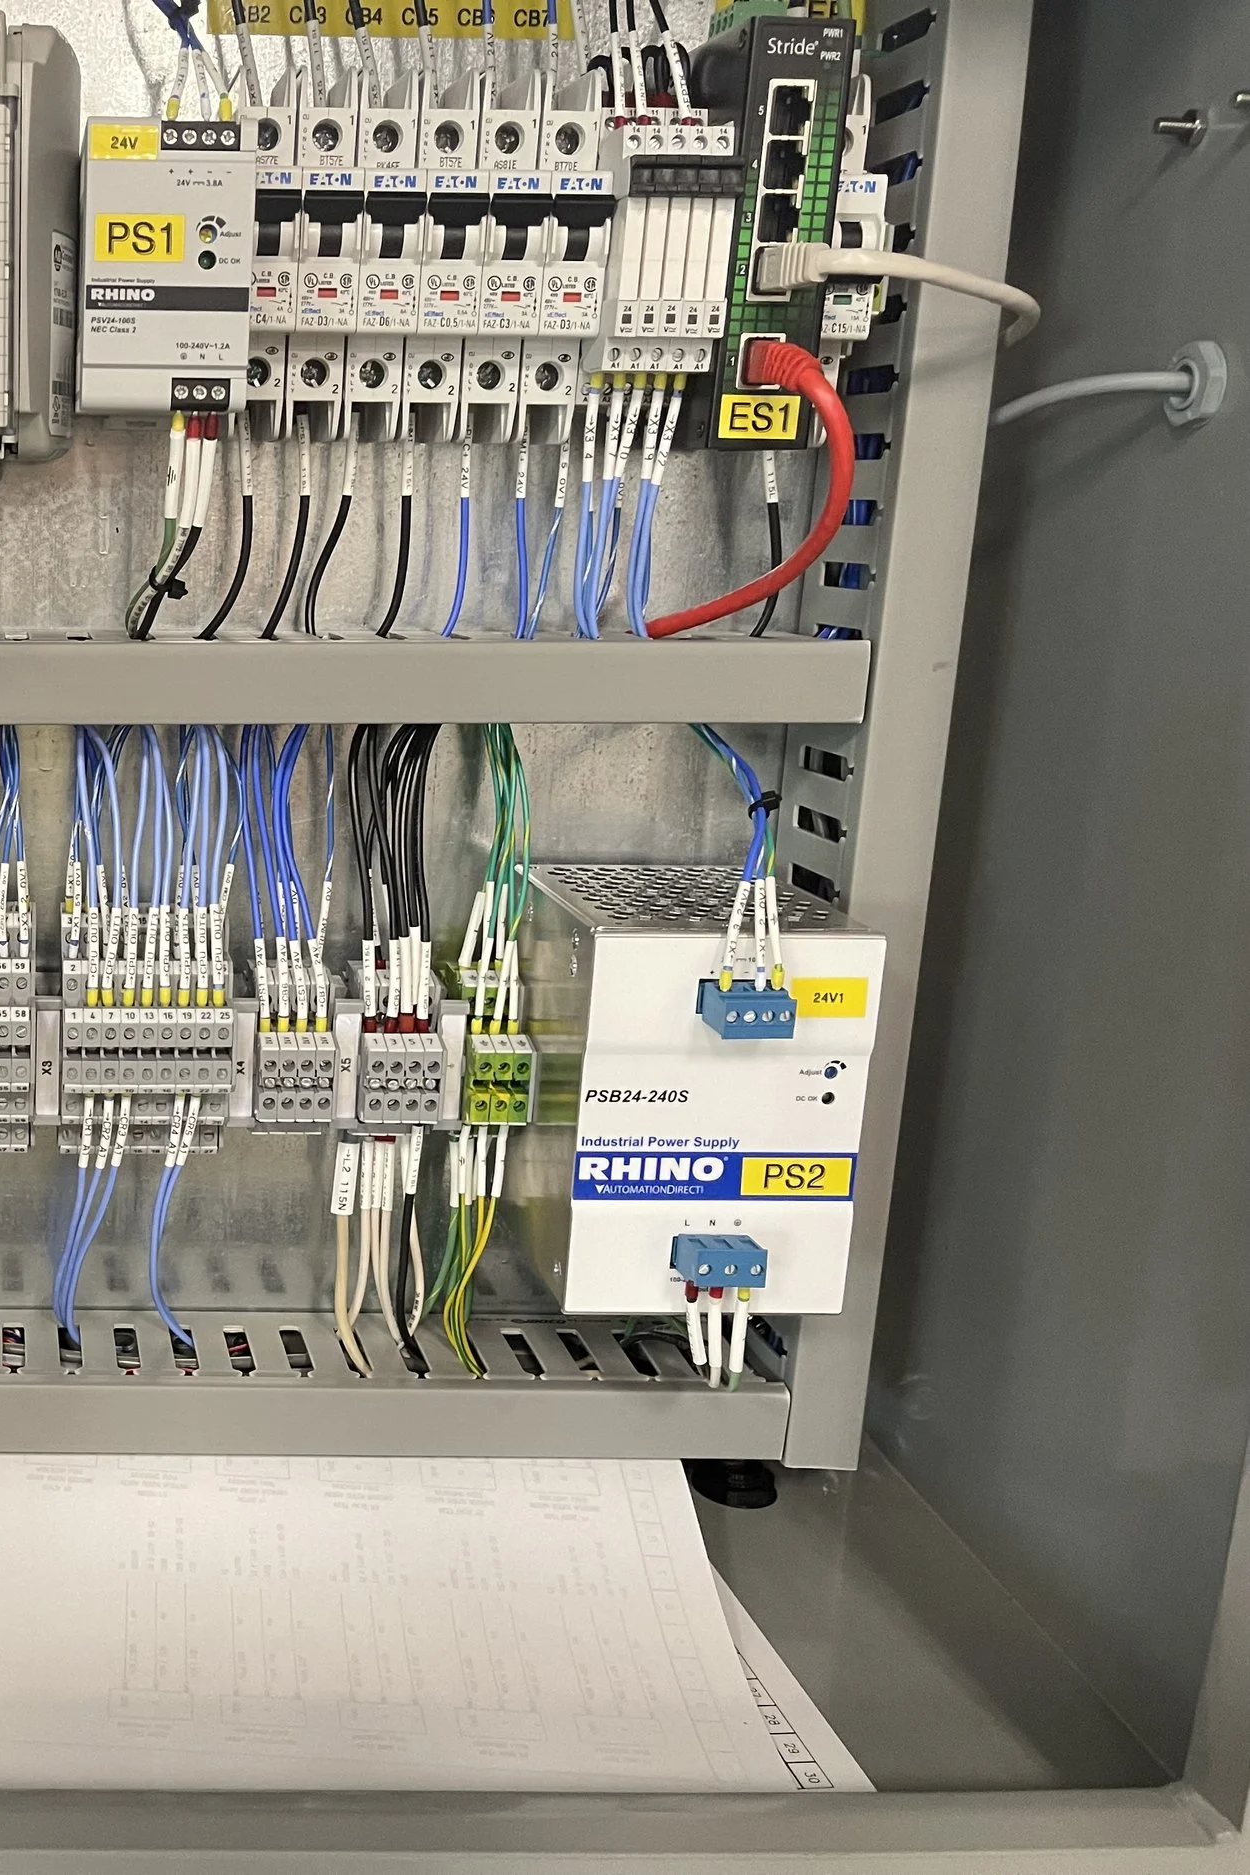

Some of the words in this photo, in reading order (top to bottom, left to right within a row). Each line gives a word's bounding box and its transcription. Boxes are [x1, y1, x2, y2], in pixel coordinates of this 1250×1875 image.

[241, 6, 271, 23] B2
[289, 6, 327, 24] C3
[402, 8, 439, 26] C5
[823, 28, 843, 38] PWR1
[767, 38, 815, 55] Stride
[820, 50, 841, 61] PWR2
[758, 105, 765, 115] 5
[111, 136, 138, 150] 24V
[752, 159, 758, 169] 4
[745, 213, 752, 222] 3
[108, 221, 173, 255] PS1
[739, 265, 746, 274] 2
[91, 288, 156, 301] RHINO
[730, 357, 735, 366] 1
[729, 402, 791, 432] ES1
[813, 992, 844, 1004] 24V1
[585, 1090, 689, 1103] PSB24-240S
[581, 1136, 643, 1147] Industrial
[648, 1136, 690, 1147] Power
[694, 1137, 740, 1150] Supply
[578, 1157, 725, 1182] RHINO
[764, 1163, 826, 1190] PS2
[764, 1714, 780, 1726] 28
[784, 1743, 800, 1754] 29
[804, 1771, 820, 1784] 30
